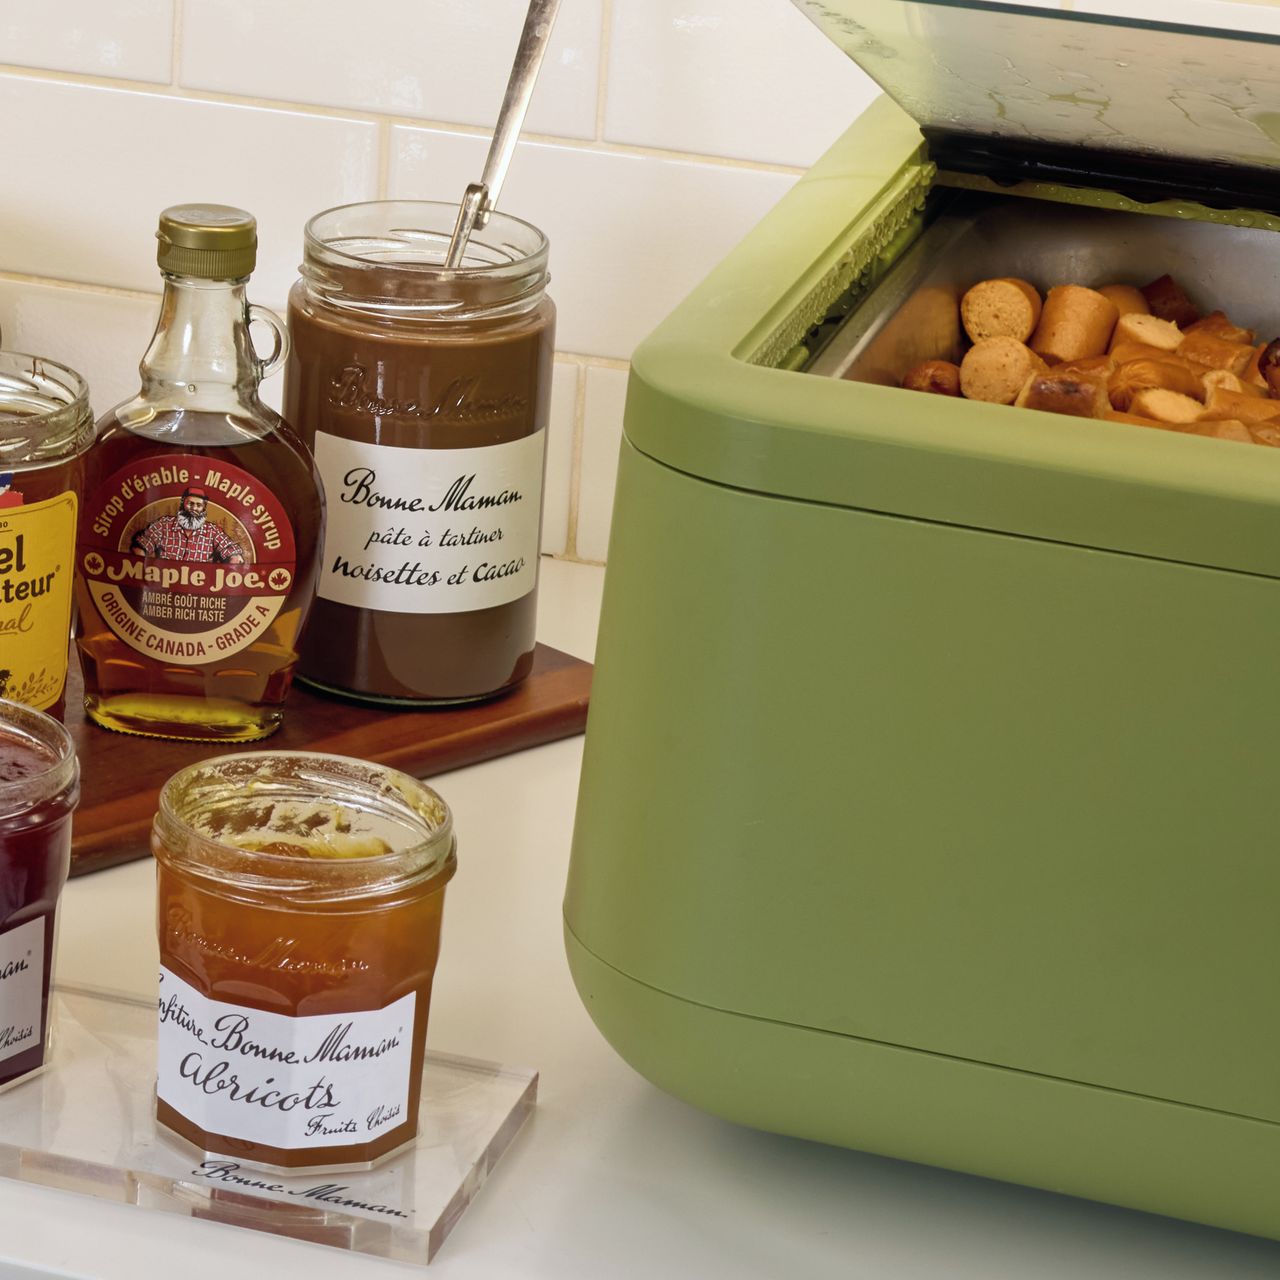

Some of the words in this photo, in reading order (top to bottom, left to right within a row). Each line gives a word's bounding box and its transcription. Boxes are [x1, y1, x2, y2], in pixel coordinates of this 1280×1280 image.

[93, 495, 124, 537] Sirop
[121, 465, 189, 500] d'érable
[204, 469, 256, 507] Maple
[251, 504, 282, 551] syrup
[340, 467, 425, 512] Bonne
[429, 473, 522, 512] Maman
[363, 527, 413, 550] pâte
[418, 530, 432, 547] à
[439, 526, 504, 547] tartiner
[107, 558, 206, 589] Maple
[209, 568, 266, 593] Joe
[447, 565, 468, 585] et
[142, 591, 173, 605] AMBRÉ
[174, 593, 197, 608] GOÛT
[200, 596, 227, 610] RICHE
[142, 605, 173, 620] AMBER
[174, 607, 195, 621] RICH
[197, 609, 225, 622] TASTE
[101, 591, 147, 642] ORIGINE
[146, 633, 207, 657] CANADA
[215, 614, 261, 651] GRADE
[257, 604, 270, 617] A
[211, 1013, 300, 1065] Bonne
[303, 1021, 400, 1064] Maman
[179, 1052, 341, 1112] Abricots
[304, 1113, 357, 1137] Fruits
[366, 1105, 401, 1130] Choisis
[191, 1160, 284, 1193] Bonne
[287, 1183, 408, 1219] Maman
